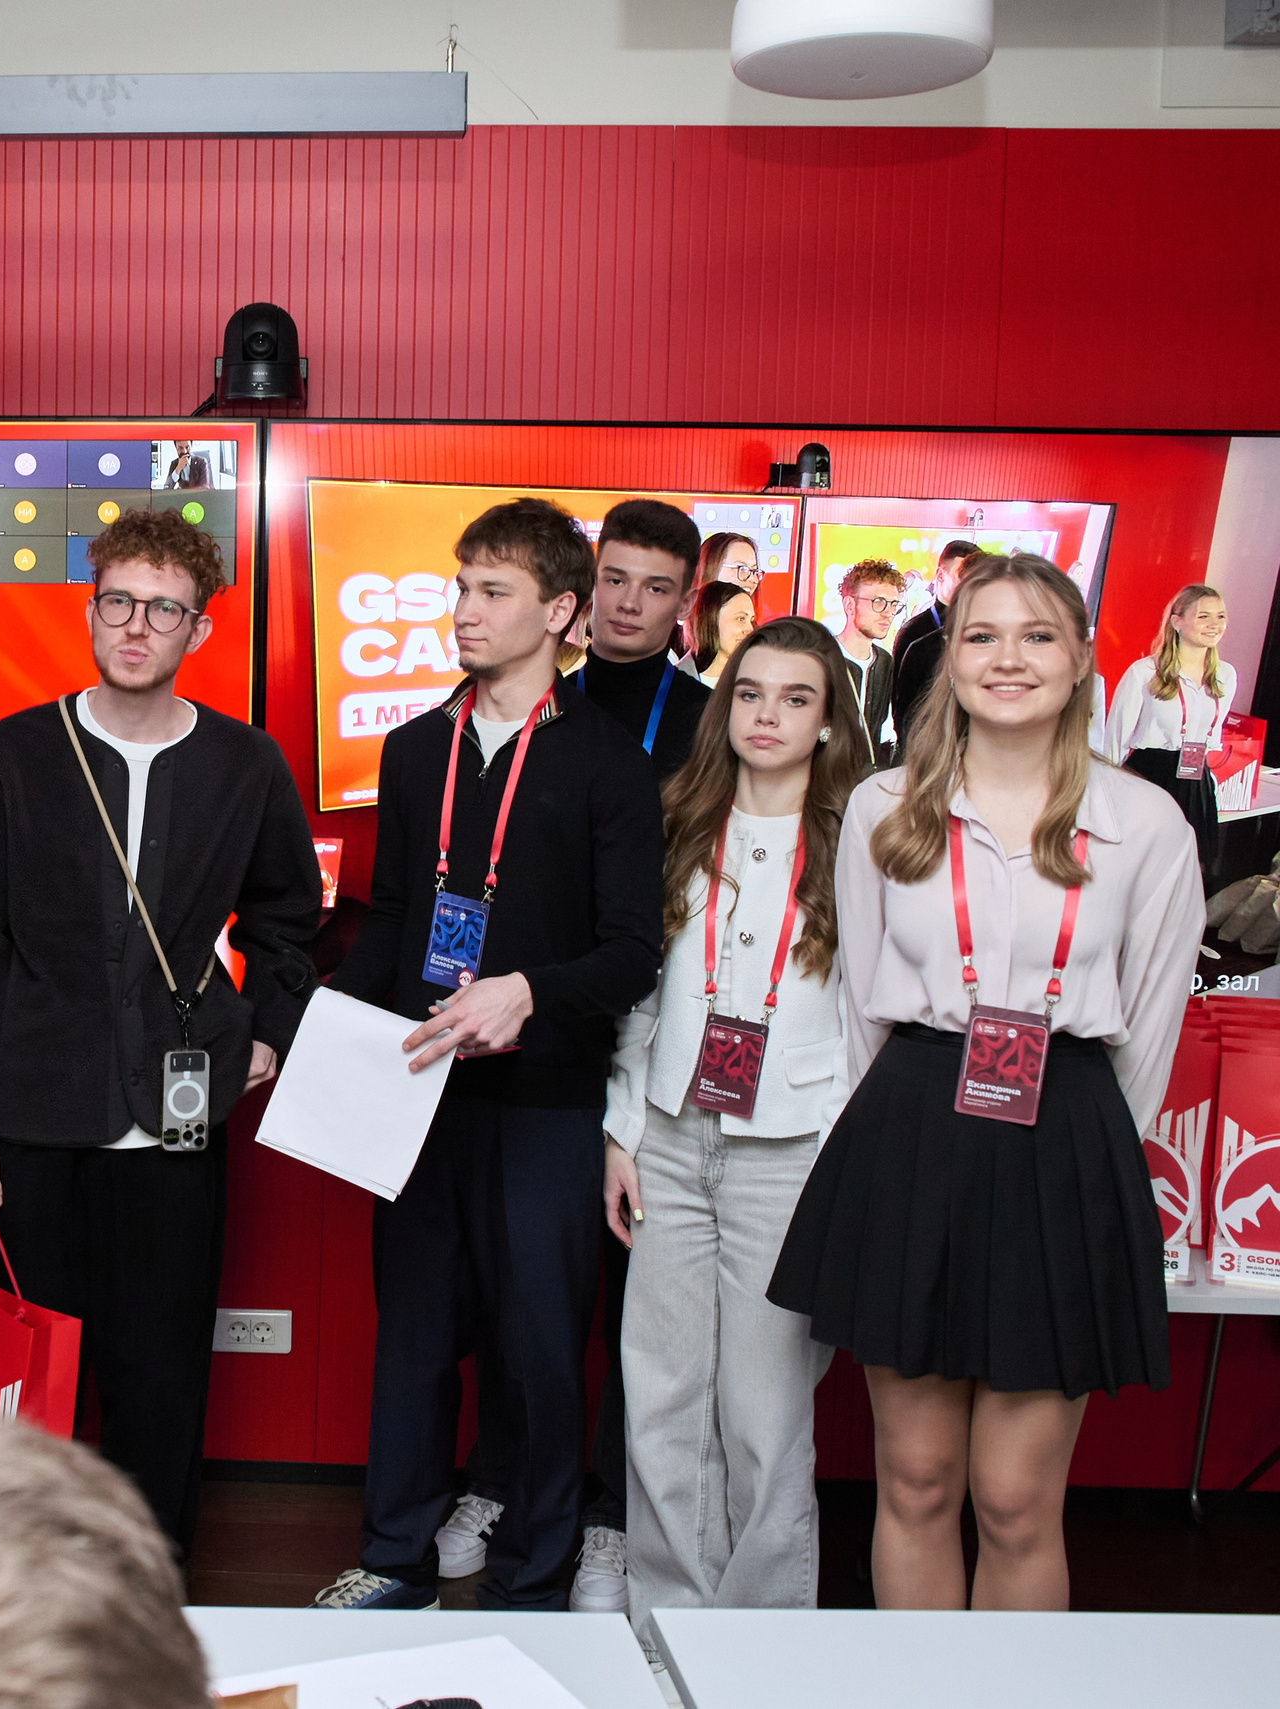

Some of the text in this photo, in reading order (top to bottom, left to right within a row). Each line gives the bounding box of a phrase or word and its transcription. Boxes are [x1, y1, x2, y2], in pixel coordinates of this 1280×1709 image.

[102, 460, 116, 469] ИА
[18, 508, 32, 516] НИ
[339, 572, 461, 624] GS
[340, 628, 463, 677] CA
[352, 706, 367, 727] 1
[1216, 974, 1260, 992] зал
[964, 1087, 1011, 1102] Акимова
[966, 1079, 1021, 1096] Екатерина
[1219, 1252, 1235, 1272] 3
